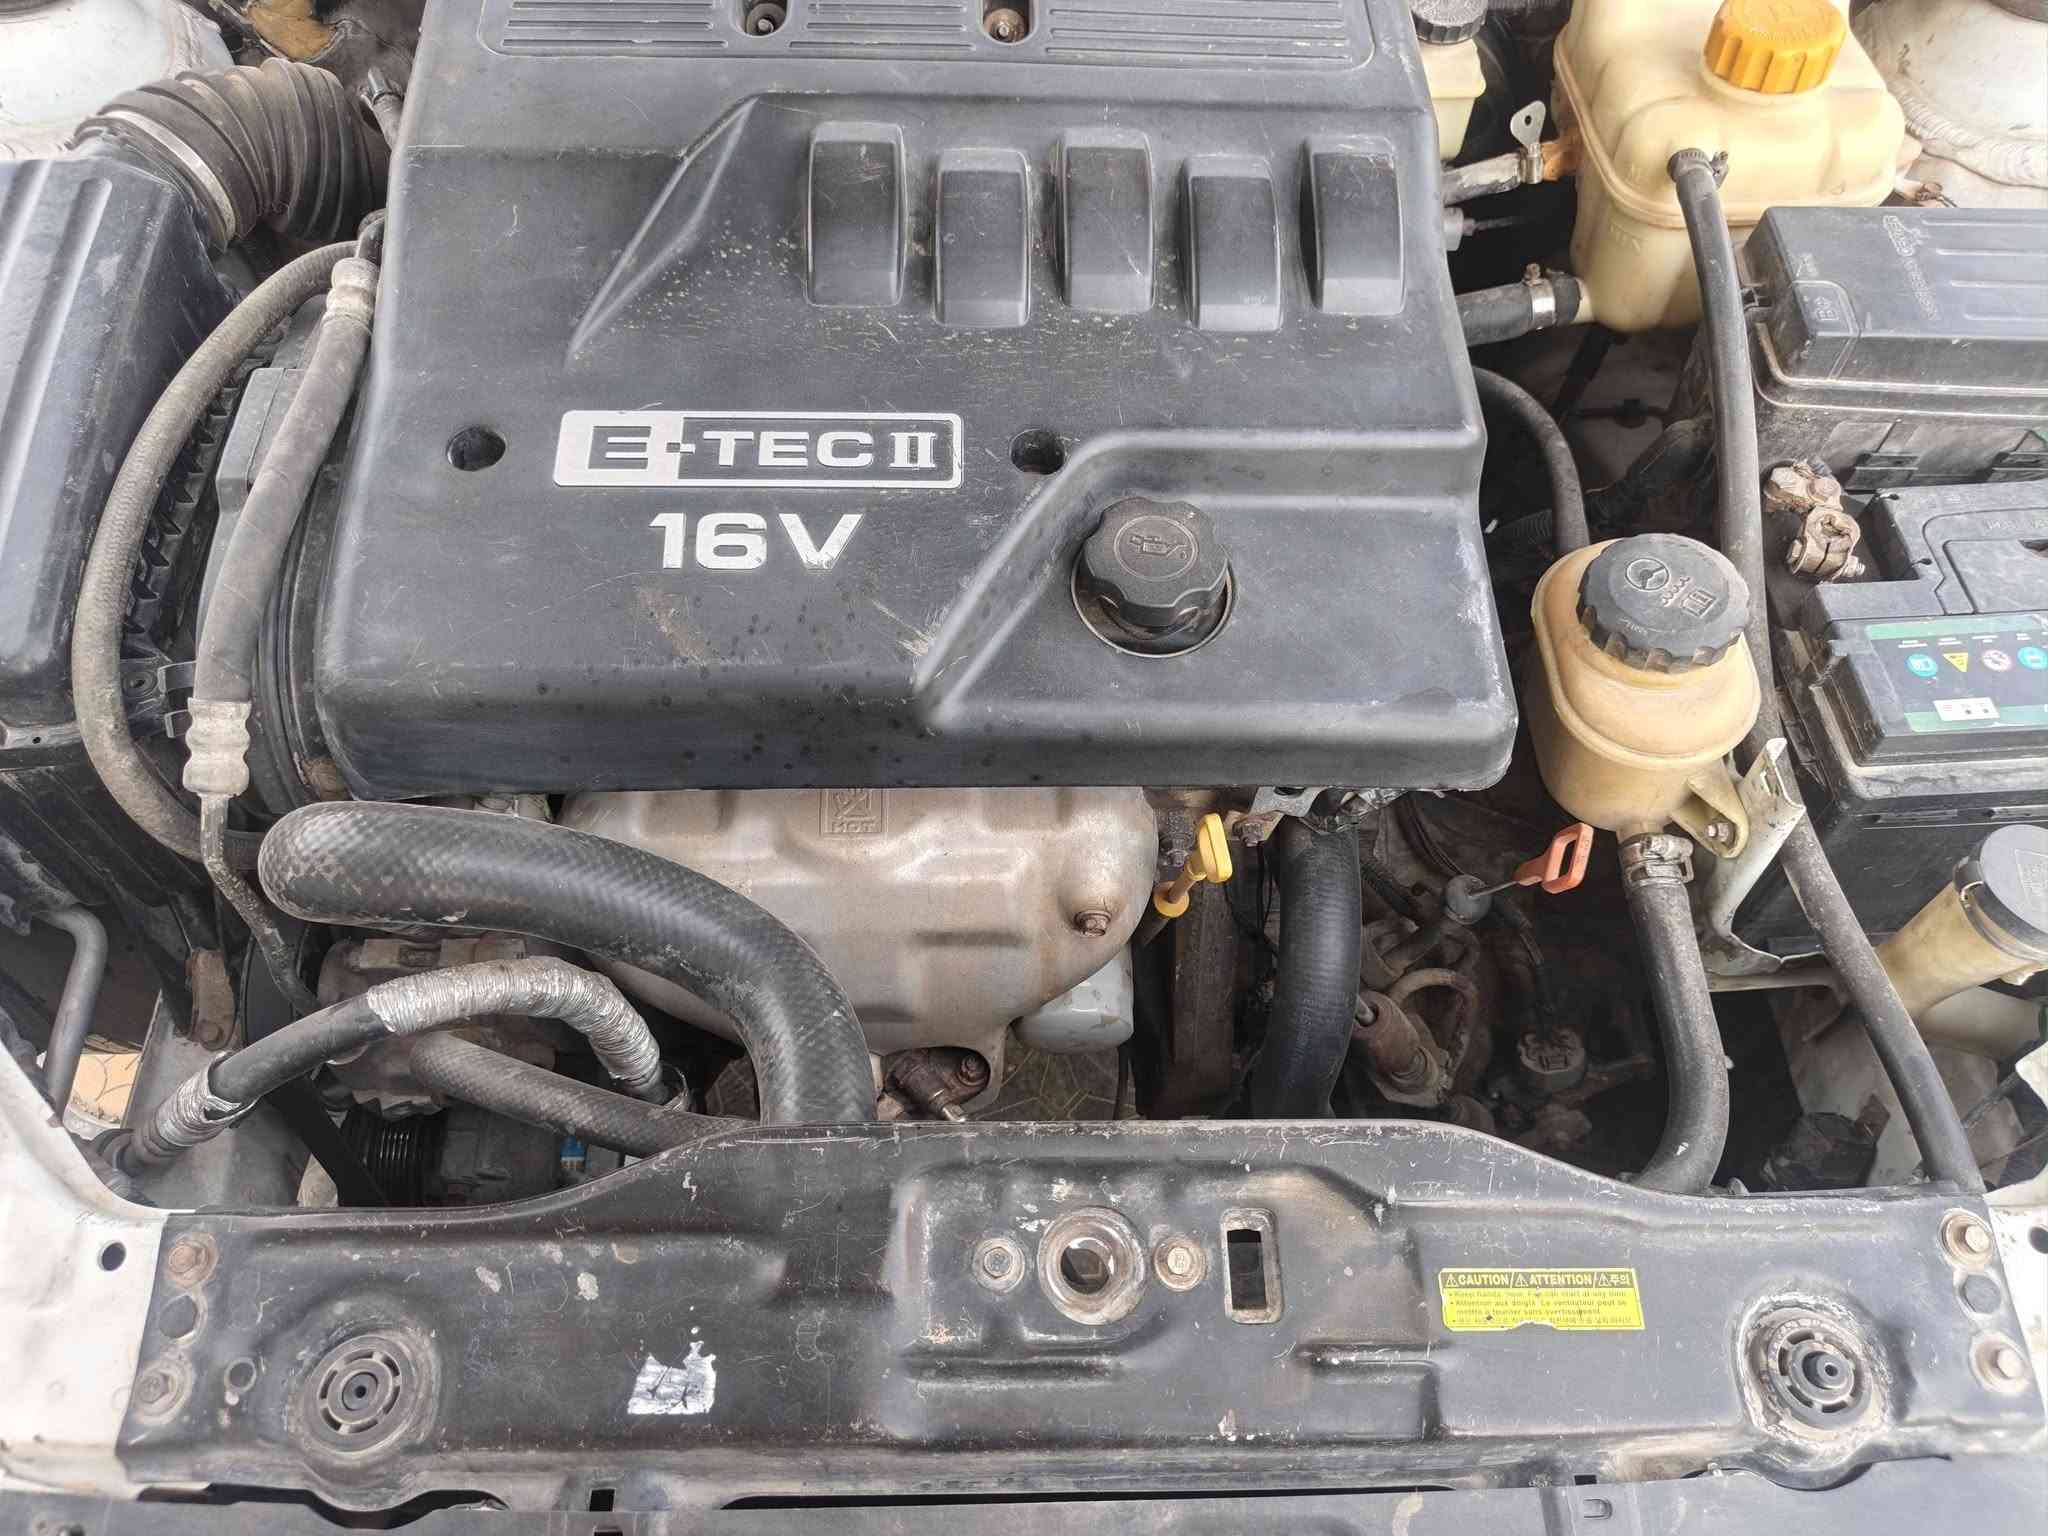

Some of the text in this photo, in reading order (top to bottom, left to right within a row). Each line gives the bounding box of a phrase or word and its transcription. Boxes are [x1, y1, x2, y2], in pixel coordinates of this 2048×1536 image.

[890, 432, 937, 468] II
[648, 512, 865, 571] 16V
[1458, 1273, 1592, 1286] CAUTION ATTENTION
